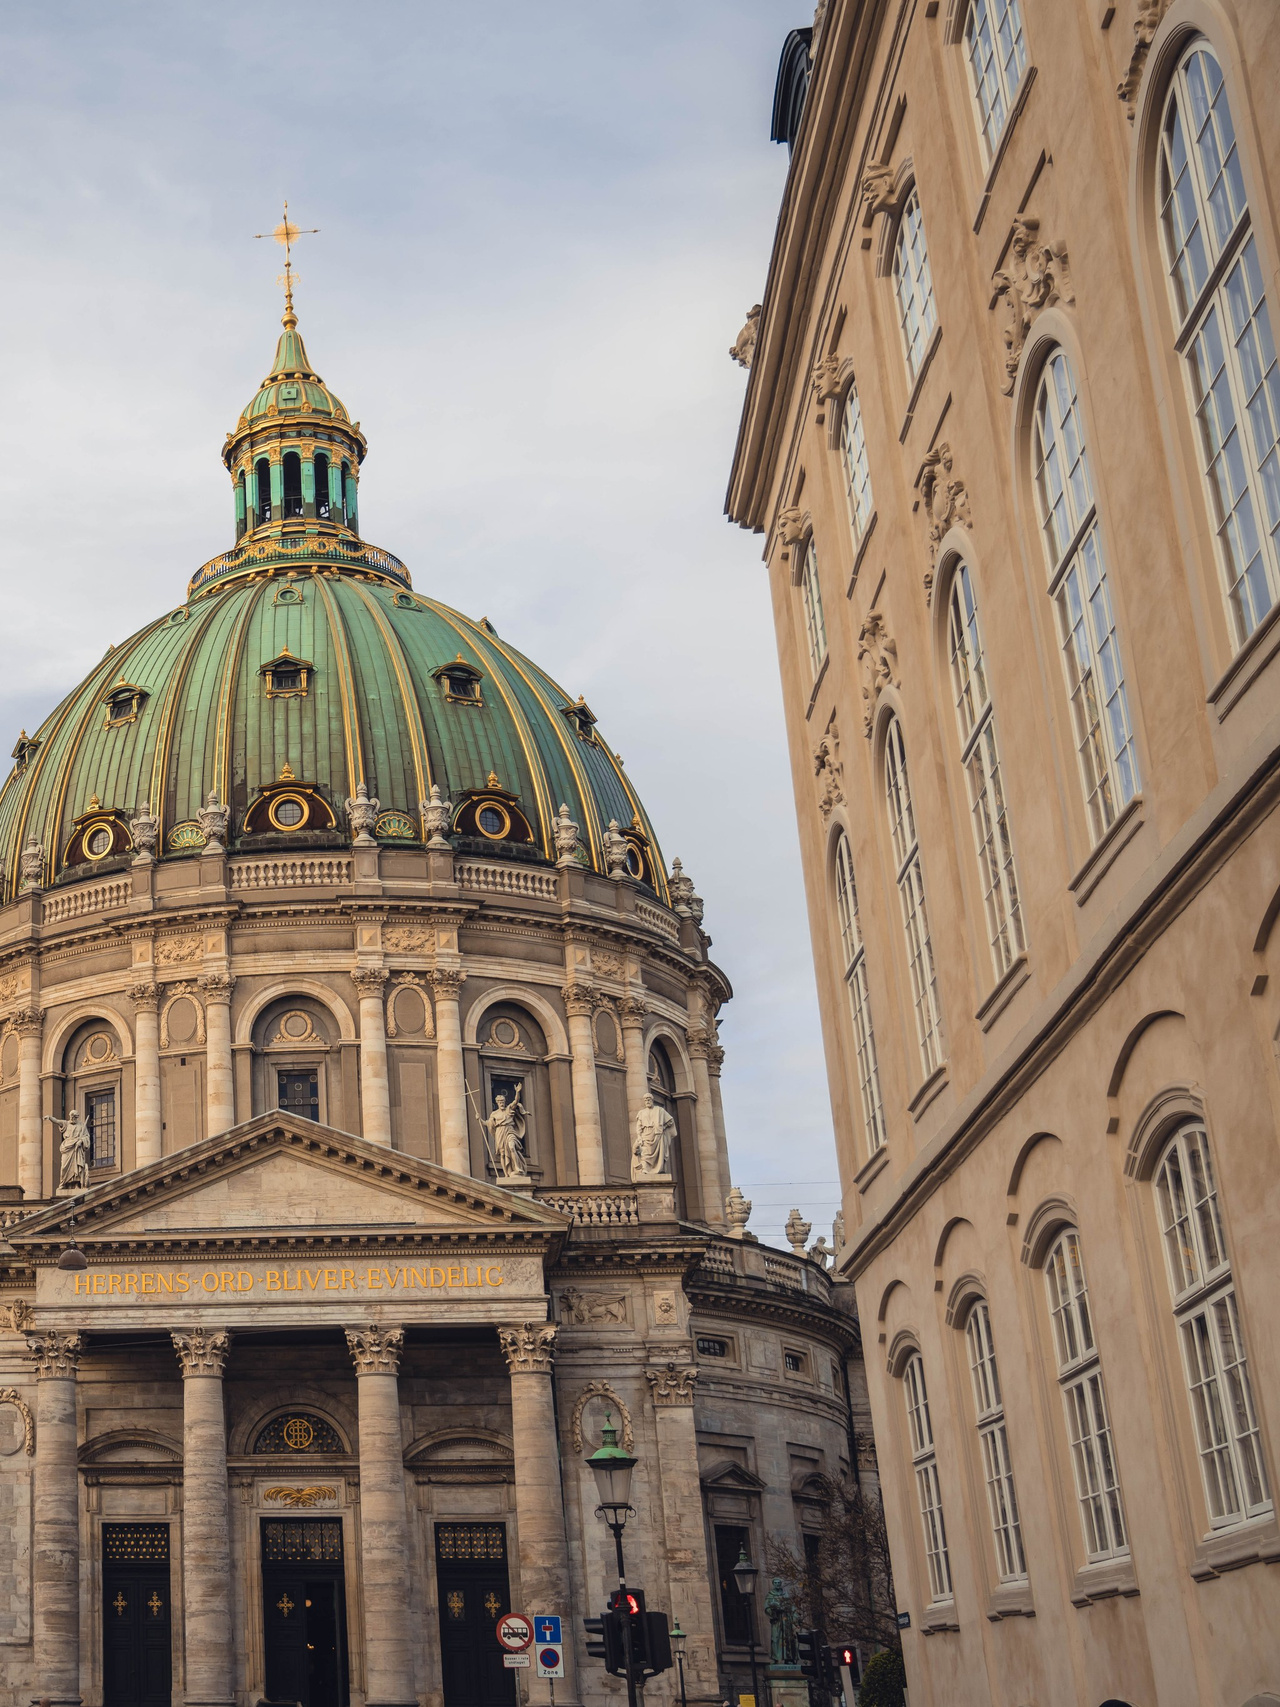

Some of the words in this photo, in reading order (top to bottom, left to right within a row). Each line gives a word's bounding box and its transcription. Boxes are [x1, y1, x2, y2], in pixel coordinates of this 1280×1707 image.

[74, 1272, 190, 1295] HERRENS
[201, 1271, 254, 1293] ORD
[265, 1269, 358, 1291] BLIVER
[366, 1266, 504, 1290] EVINDELIG
